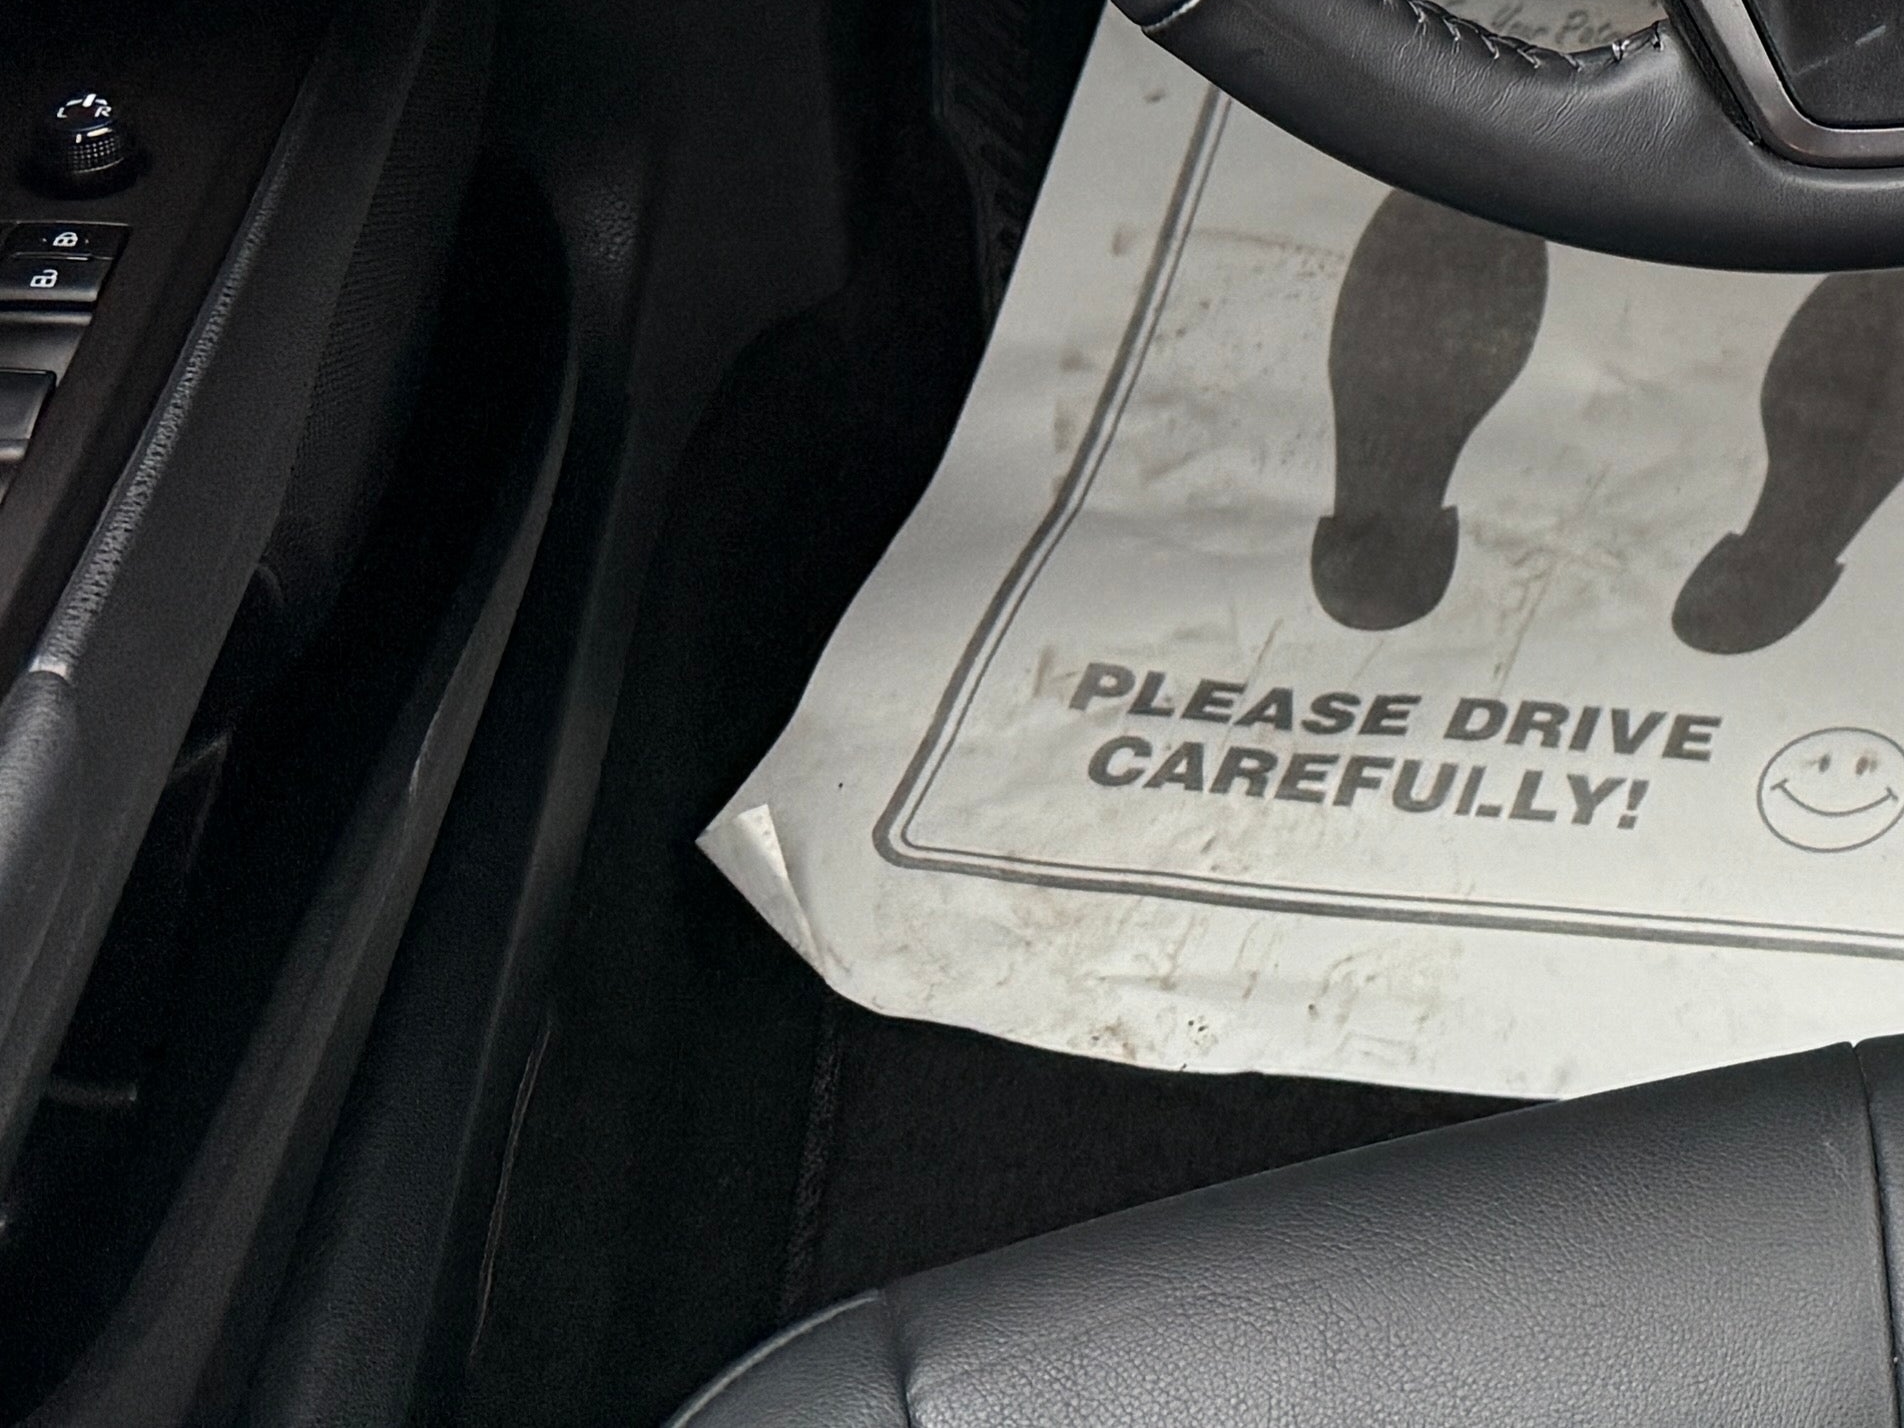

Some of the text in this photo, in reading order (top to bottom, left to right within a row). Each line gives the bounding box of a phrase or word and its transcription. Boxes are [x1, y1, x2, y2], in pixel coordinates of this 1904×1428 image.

[95, 105, 113, 118] R
[1068, 661, 1722, 762] PLEASE DRIVE
[1087, 734, 1650, 830] CAREFULLY!
